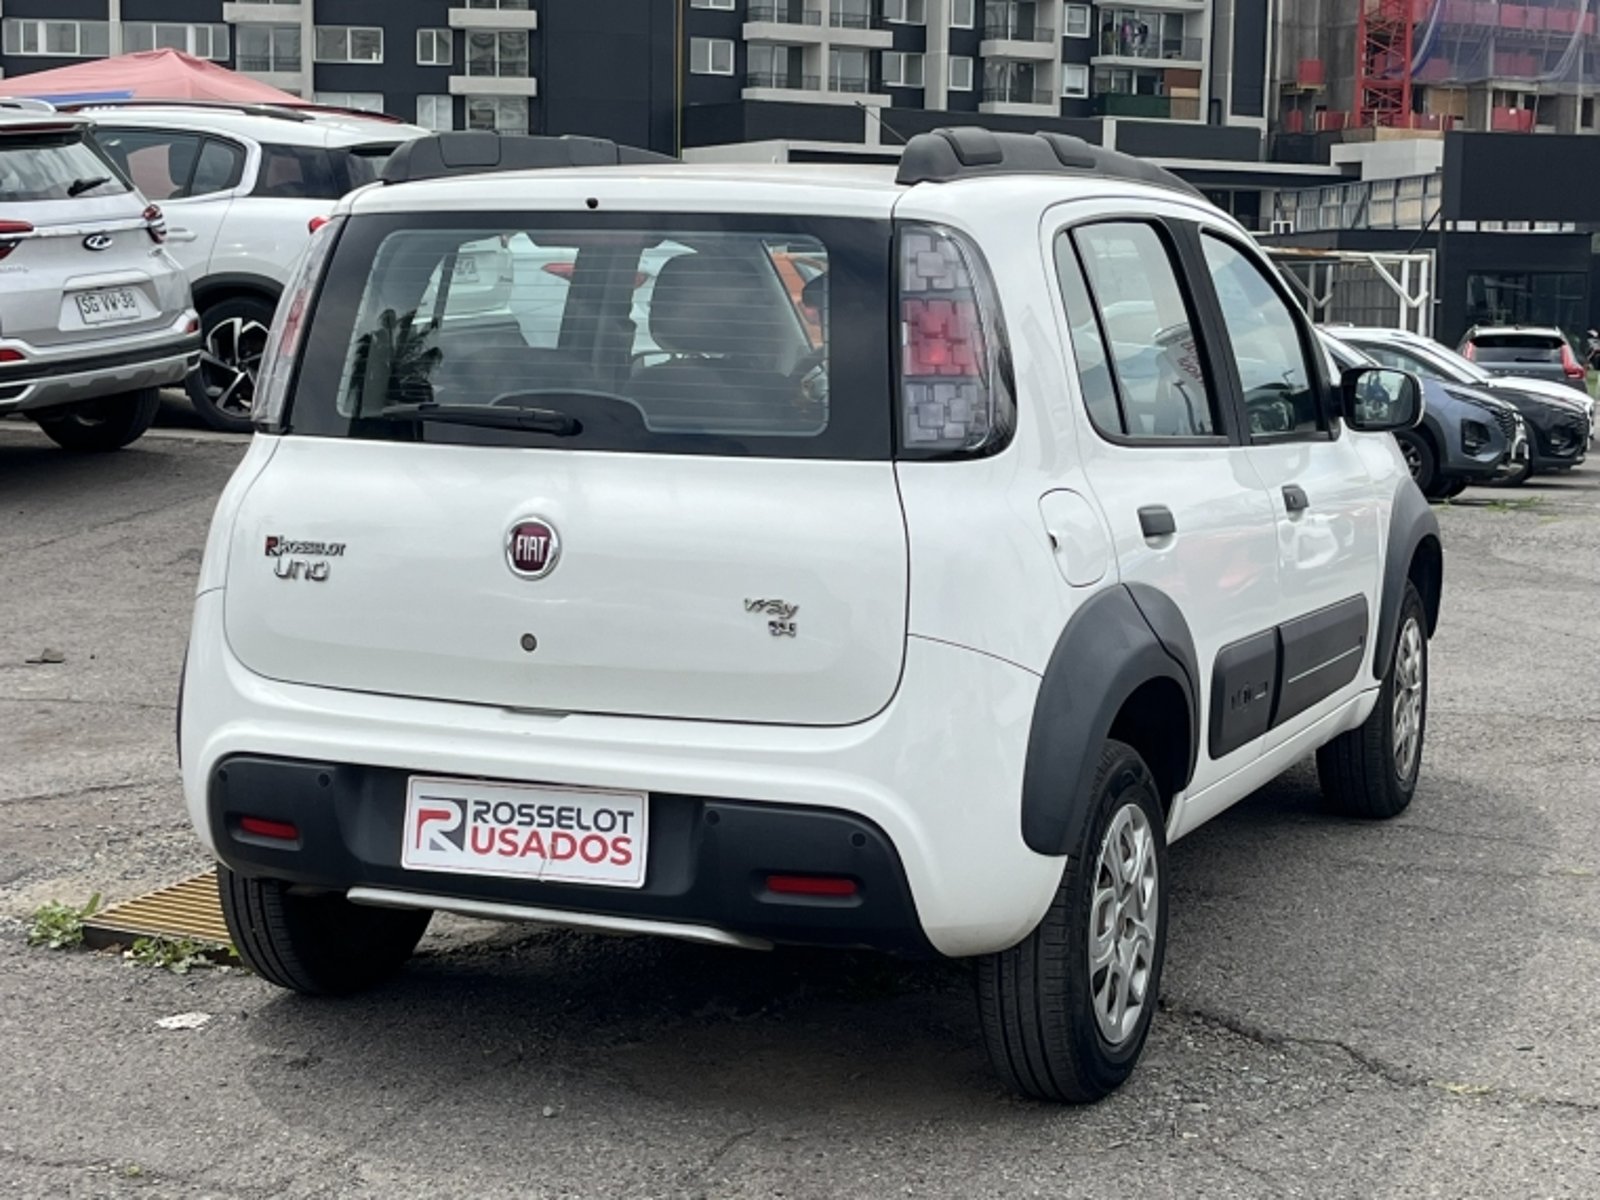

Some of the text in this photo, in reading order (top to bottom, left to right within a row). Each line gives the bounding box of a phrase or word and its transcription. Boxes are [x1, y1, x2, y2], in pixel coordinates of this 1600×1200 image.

[515, 534, 548, 563] FIAT
[473, 801, 635, 834] ROSSELOT
[470, 826, 633, 866] USADOS
